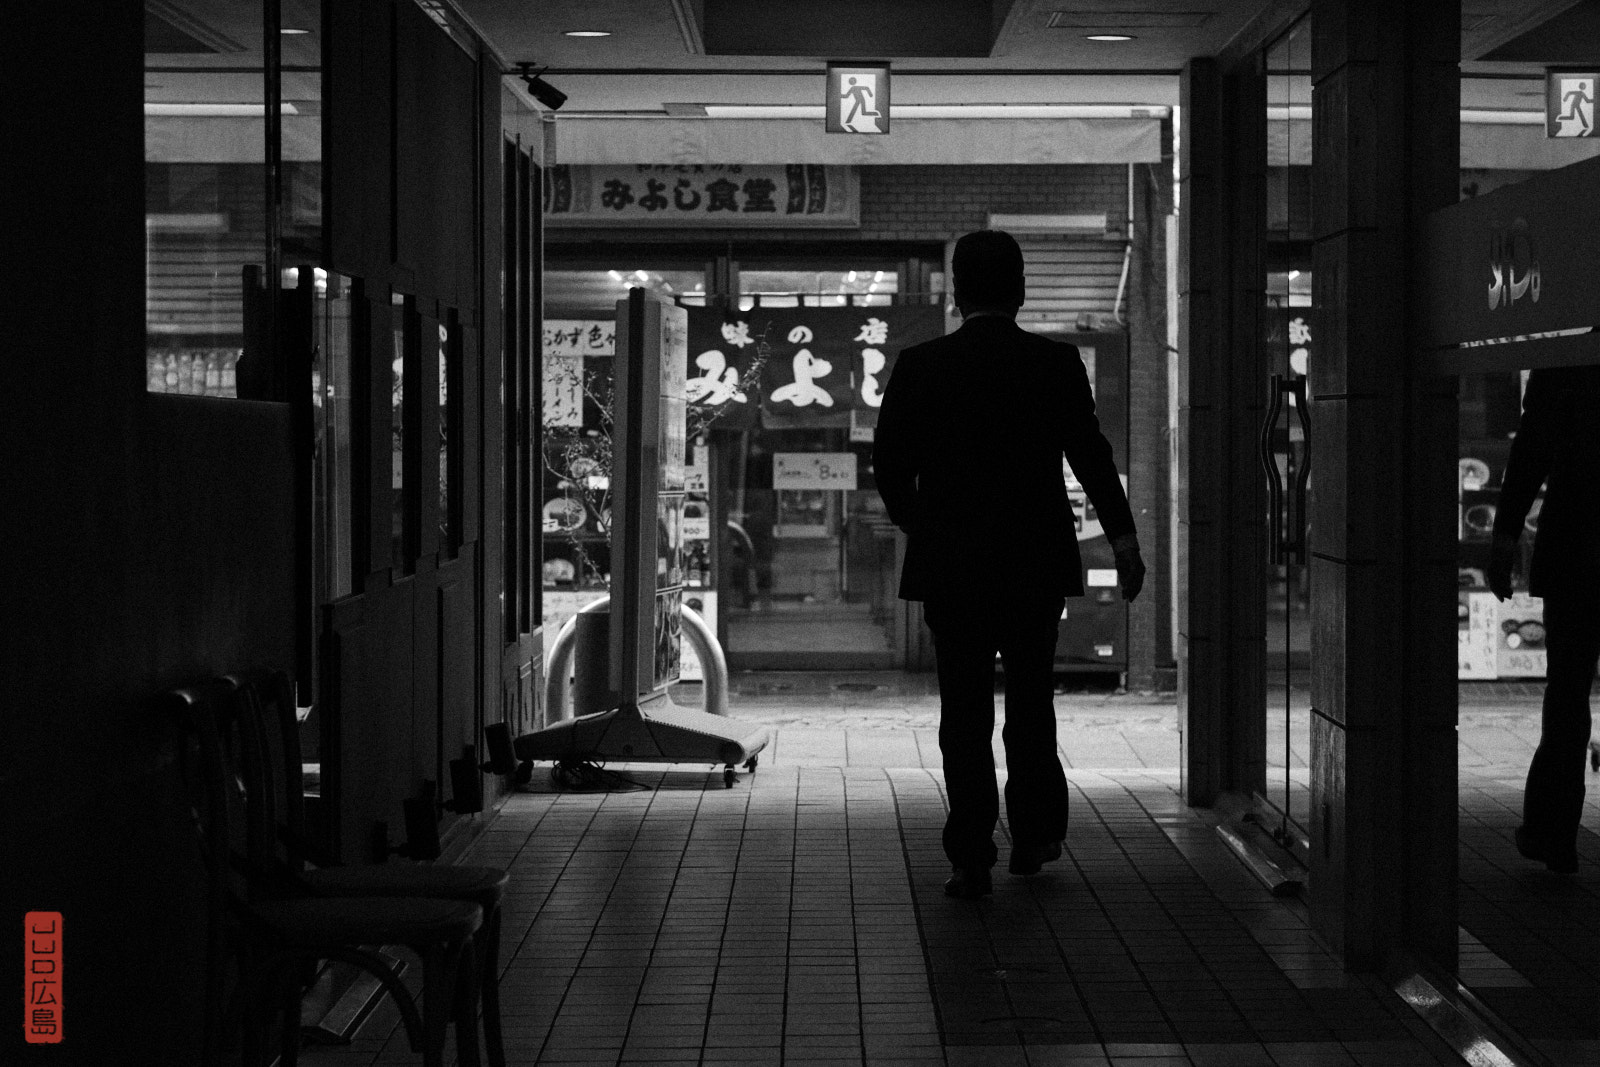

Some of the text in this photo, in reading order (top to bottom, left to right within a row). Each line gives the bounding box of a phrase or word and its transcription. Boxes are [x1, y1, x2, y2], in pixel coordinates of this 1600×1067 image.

[601, 177, 777, 213] みよし食堂
[686, 347, 886, 408] みよし
